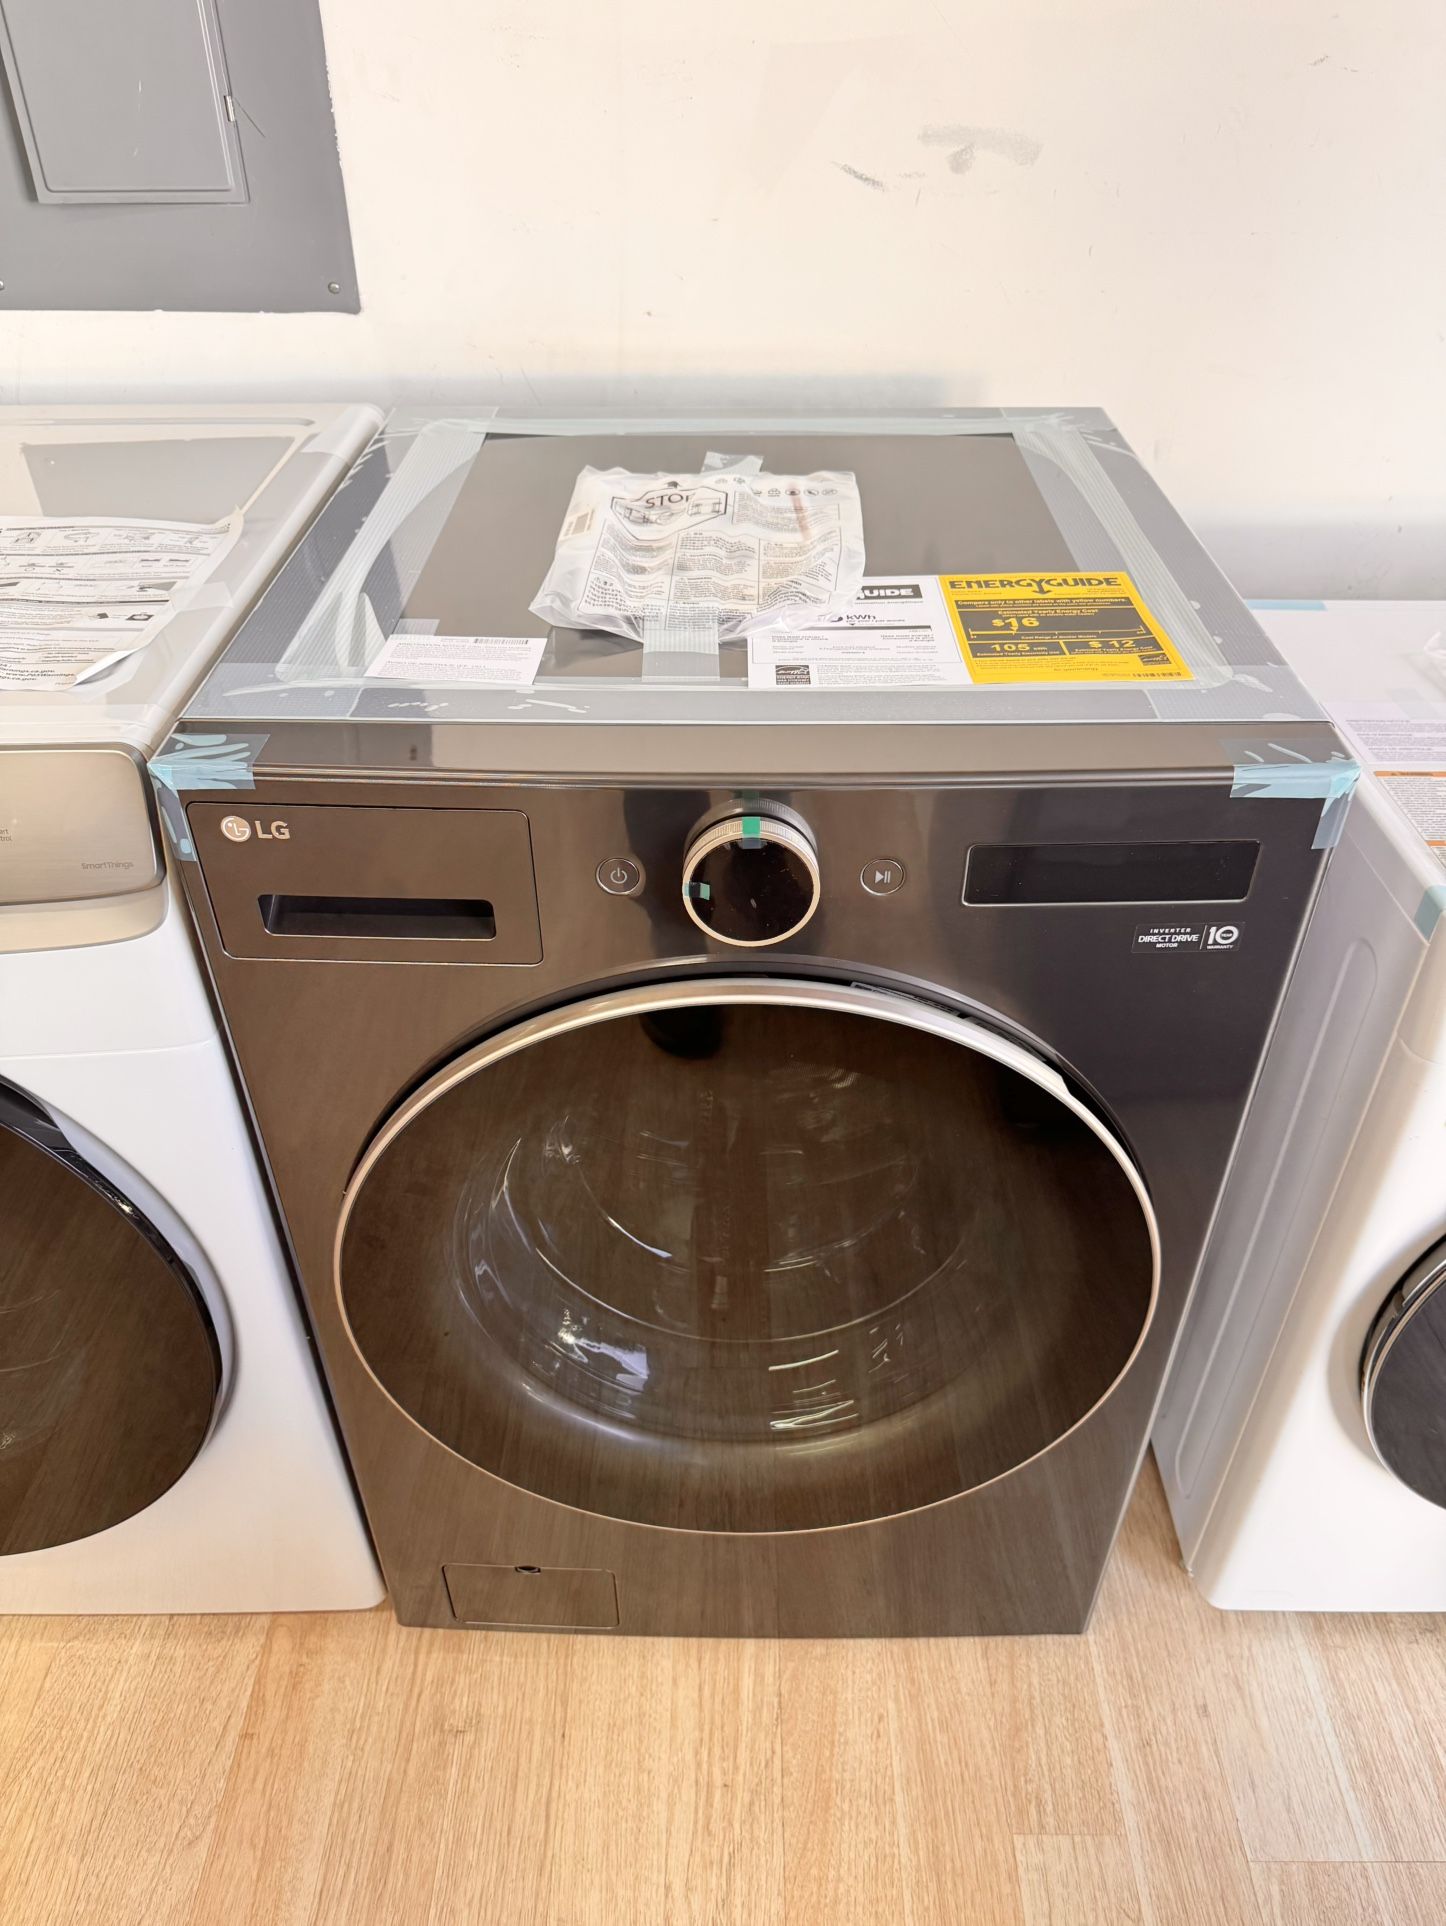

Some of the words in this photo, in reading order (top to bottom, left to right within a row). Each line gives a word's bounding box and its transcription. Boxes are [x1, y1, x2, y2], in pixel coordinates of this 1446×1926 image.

[949, 577, 1122, 593] ENERGYGUIDE
[992, 617, 1040, 627] $16
[991, 643, 1030, 652] 105
[1108, 640, 1136, 648] 12
[254, 820, 291, 839] LG
[81, 861, 134, 870] SmartThings
[1138, 934, 1171, 943] DIRECT
[1171, 934, 1200, 942] DRIVE
[1207, 925, 1240, 945] 10
